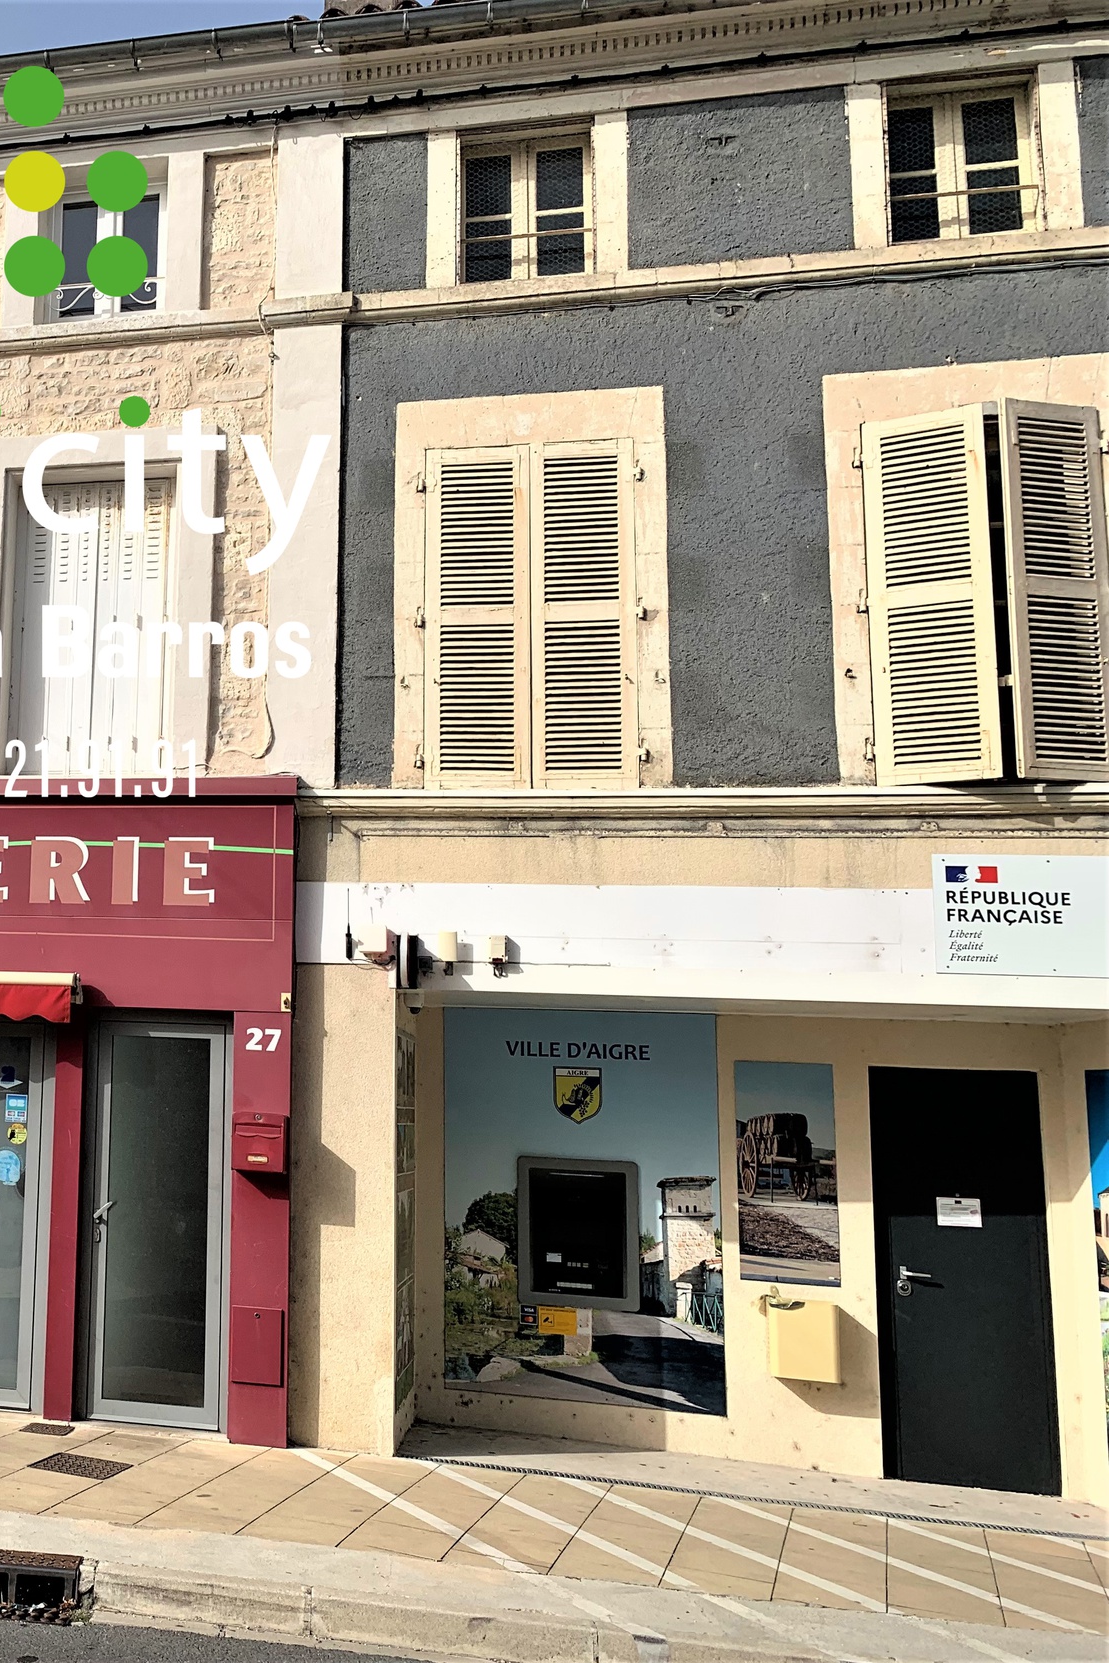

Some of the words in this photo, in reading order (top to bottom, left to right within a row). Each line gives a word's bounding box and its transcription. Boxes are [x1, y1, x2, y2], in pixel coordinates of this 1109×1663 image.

[946, 887, 1071, 908] RÉPUBLIQUE
[947, 908, 1063, 926] FRANÇAISE
[948, 929, 983, 939] Liberté
[949, 940, 984, 952] Égalité
[949, 953, 999, 963] Fraternité
[245, 1027, 282, 1052] 27
[505, 1040, 561, 1058] VILLE
[567, 1041, 651, 1061] D'AIGRE
